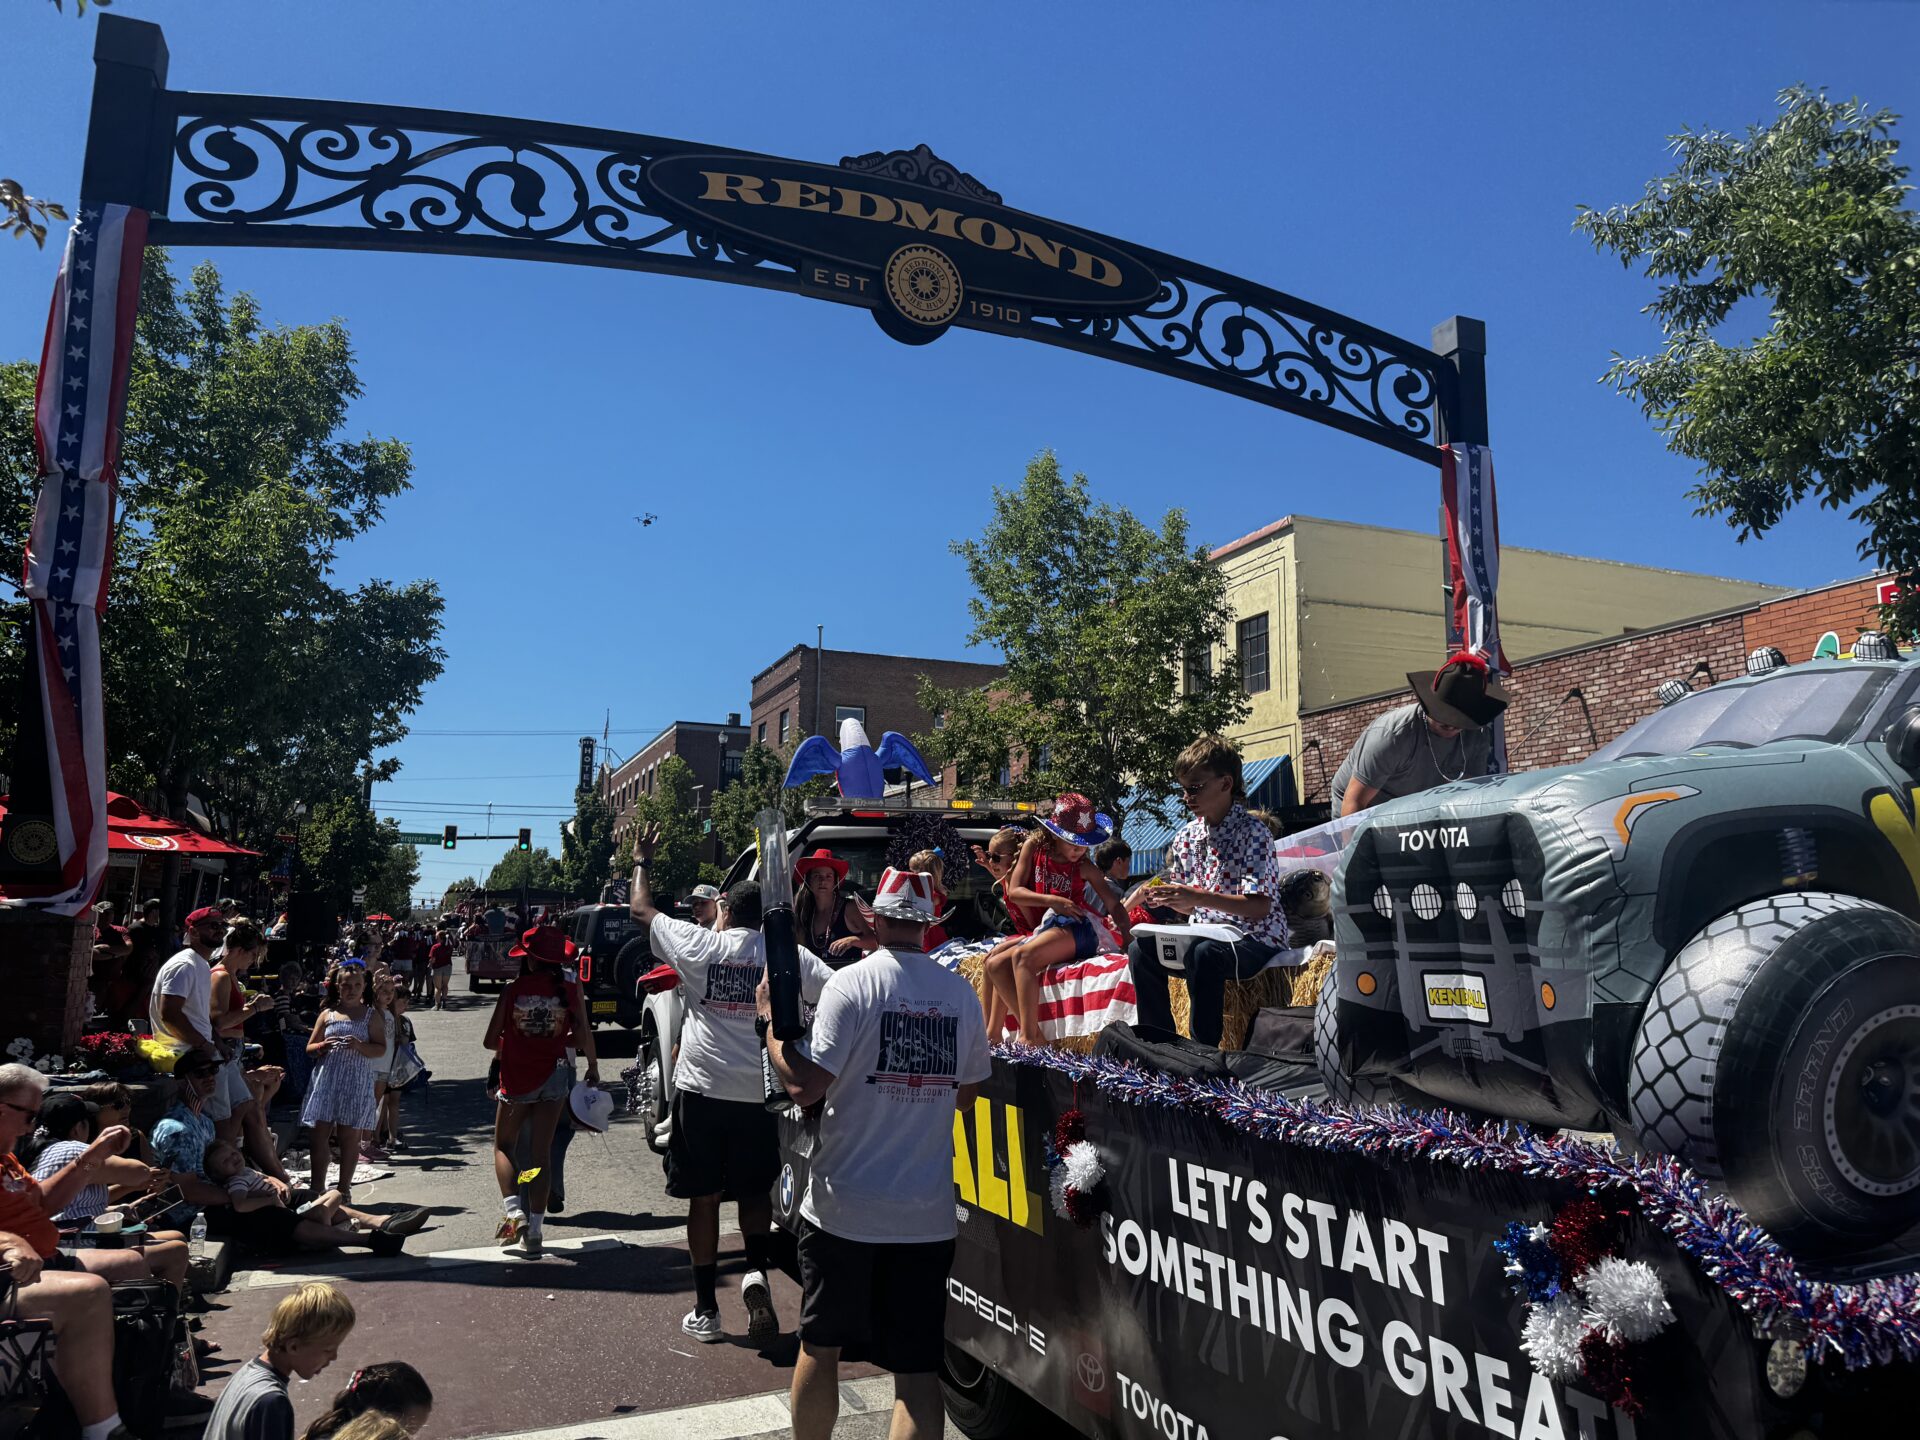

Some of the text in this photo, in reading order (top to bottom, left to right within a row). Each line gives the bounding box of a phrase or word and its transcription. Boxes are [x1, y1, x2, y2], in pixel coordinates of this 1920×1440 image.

[698, 170, 1123, 288] REDMOND
[813, 268, 870, 292] EST
[904, 260, 945, 281] REDMOND
[905, 290, 945, 309] THE HUB
[970, 300, 1021, 324] 1910
[582, 747, 592, 789] HOTEL
[400, 835, 427, 844] ergreen
[1398, 826, 1470, 852] TOYOTA
[605, 920, 620, 928] BEND
[1427, 987, 1486, 1009] KENDALL
[1793, 998, 1855, 1132] BRAND
[878, 1085, 951, 1097] DESCHUTES COUNTY
[1168, 1157, 1449, 1306] LET'S START
[946, 1277, 1046, 1356] ORSCHE
[1102, 1210, 1637, 1440] SOMETHING GREAT
